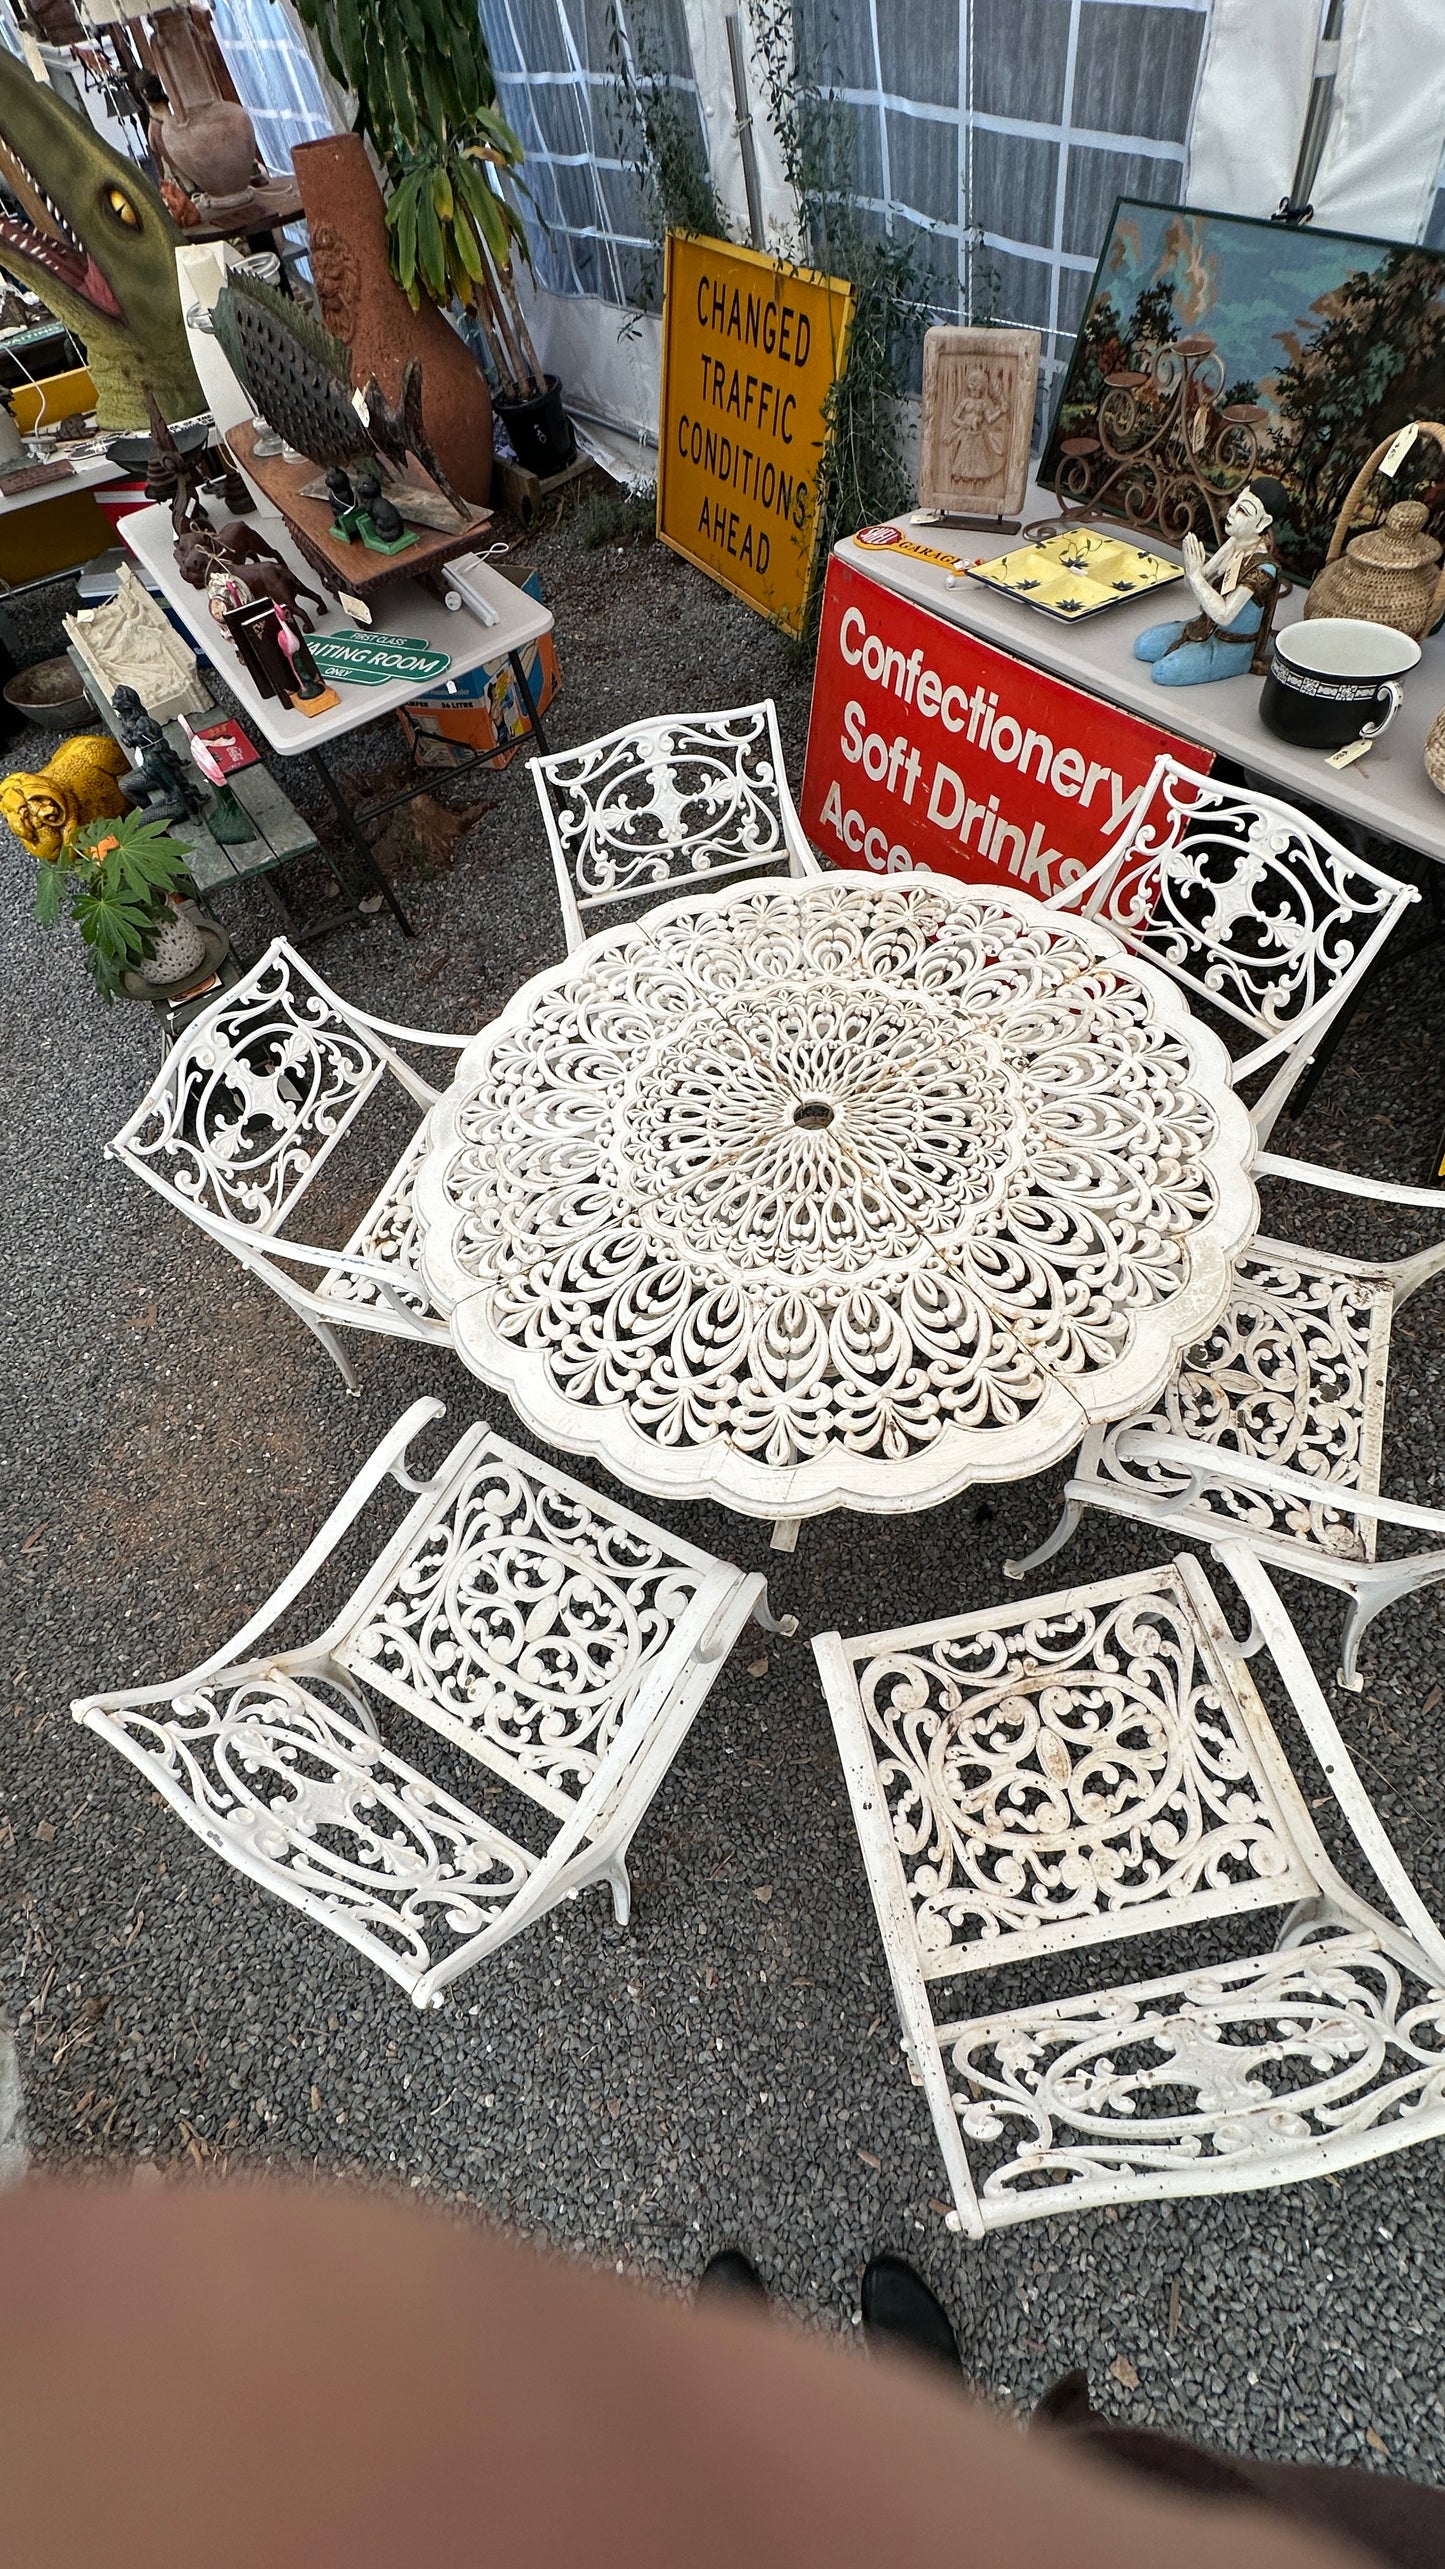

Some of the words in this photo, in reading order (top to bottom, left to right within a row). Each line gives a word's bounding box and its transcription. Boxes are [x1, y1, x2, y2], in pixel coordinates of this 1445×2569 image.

[697, 275, 811, 368] CHANGED
[701, 353, 797, 444] TRAFFIC
[678, 414, 808, 529] CONDITIONS
[698, 496, 770, 575] AHEAD
[307, 641, 372, 662] AITING
[367, 652, 440, 672] ROOM
[325, 667, 353, 677] ONLY
[351, 632, 379, 641] FIRST
[376, 636, 407, 646] CLASS
[840, 606, 1146, 836] Confectionery
[819, 780, 932, 874] Acce
[840, 700, 923, 805] Soft
[926, 761, 1087, 908] Drinks
